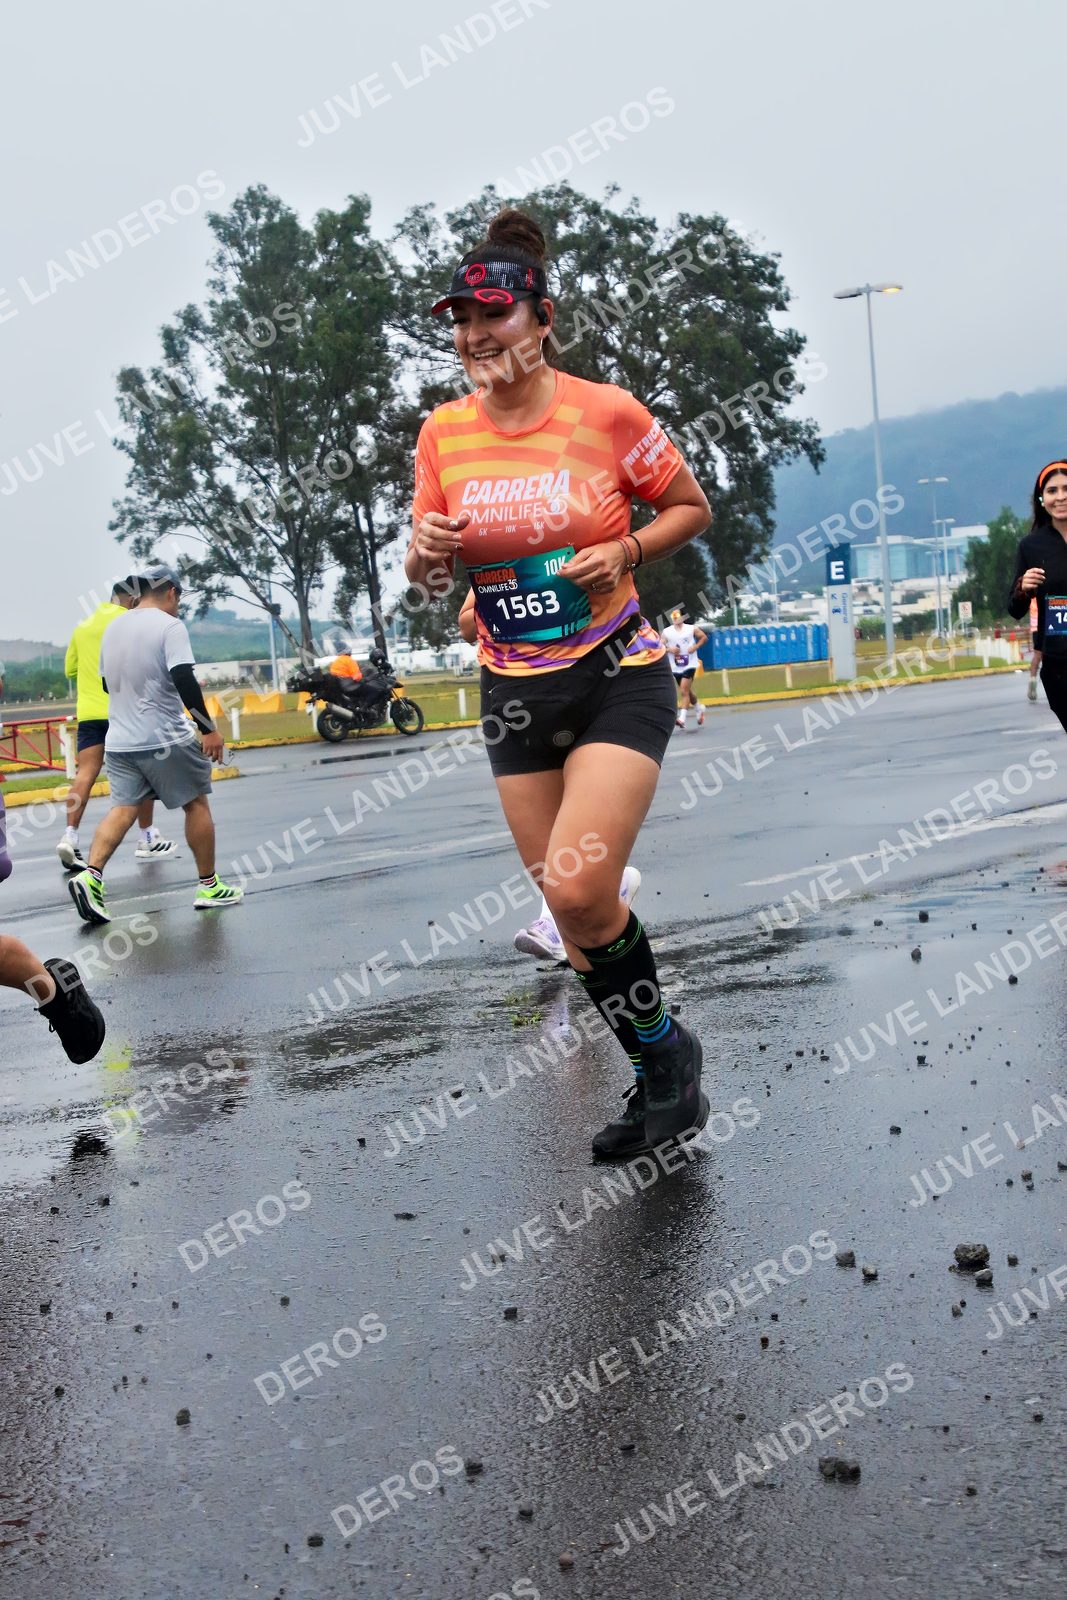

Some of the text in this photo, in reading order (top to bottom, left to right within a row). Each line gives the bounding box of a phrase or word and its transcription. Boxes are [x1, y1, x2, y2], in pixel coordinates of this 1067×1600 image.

[461, 469, 569, 505] CARRERA
[474, 567, 517, 585] CARRERA
[544, 555, 567, 577] 10K
[830, 561, 845, 580] E
[496, 590, 560, 620] 1563
